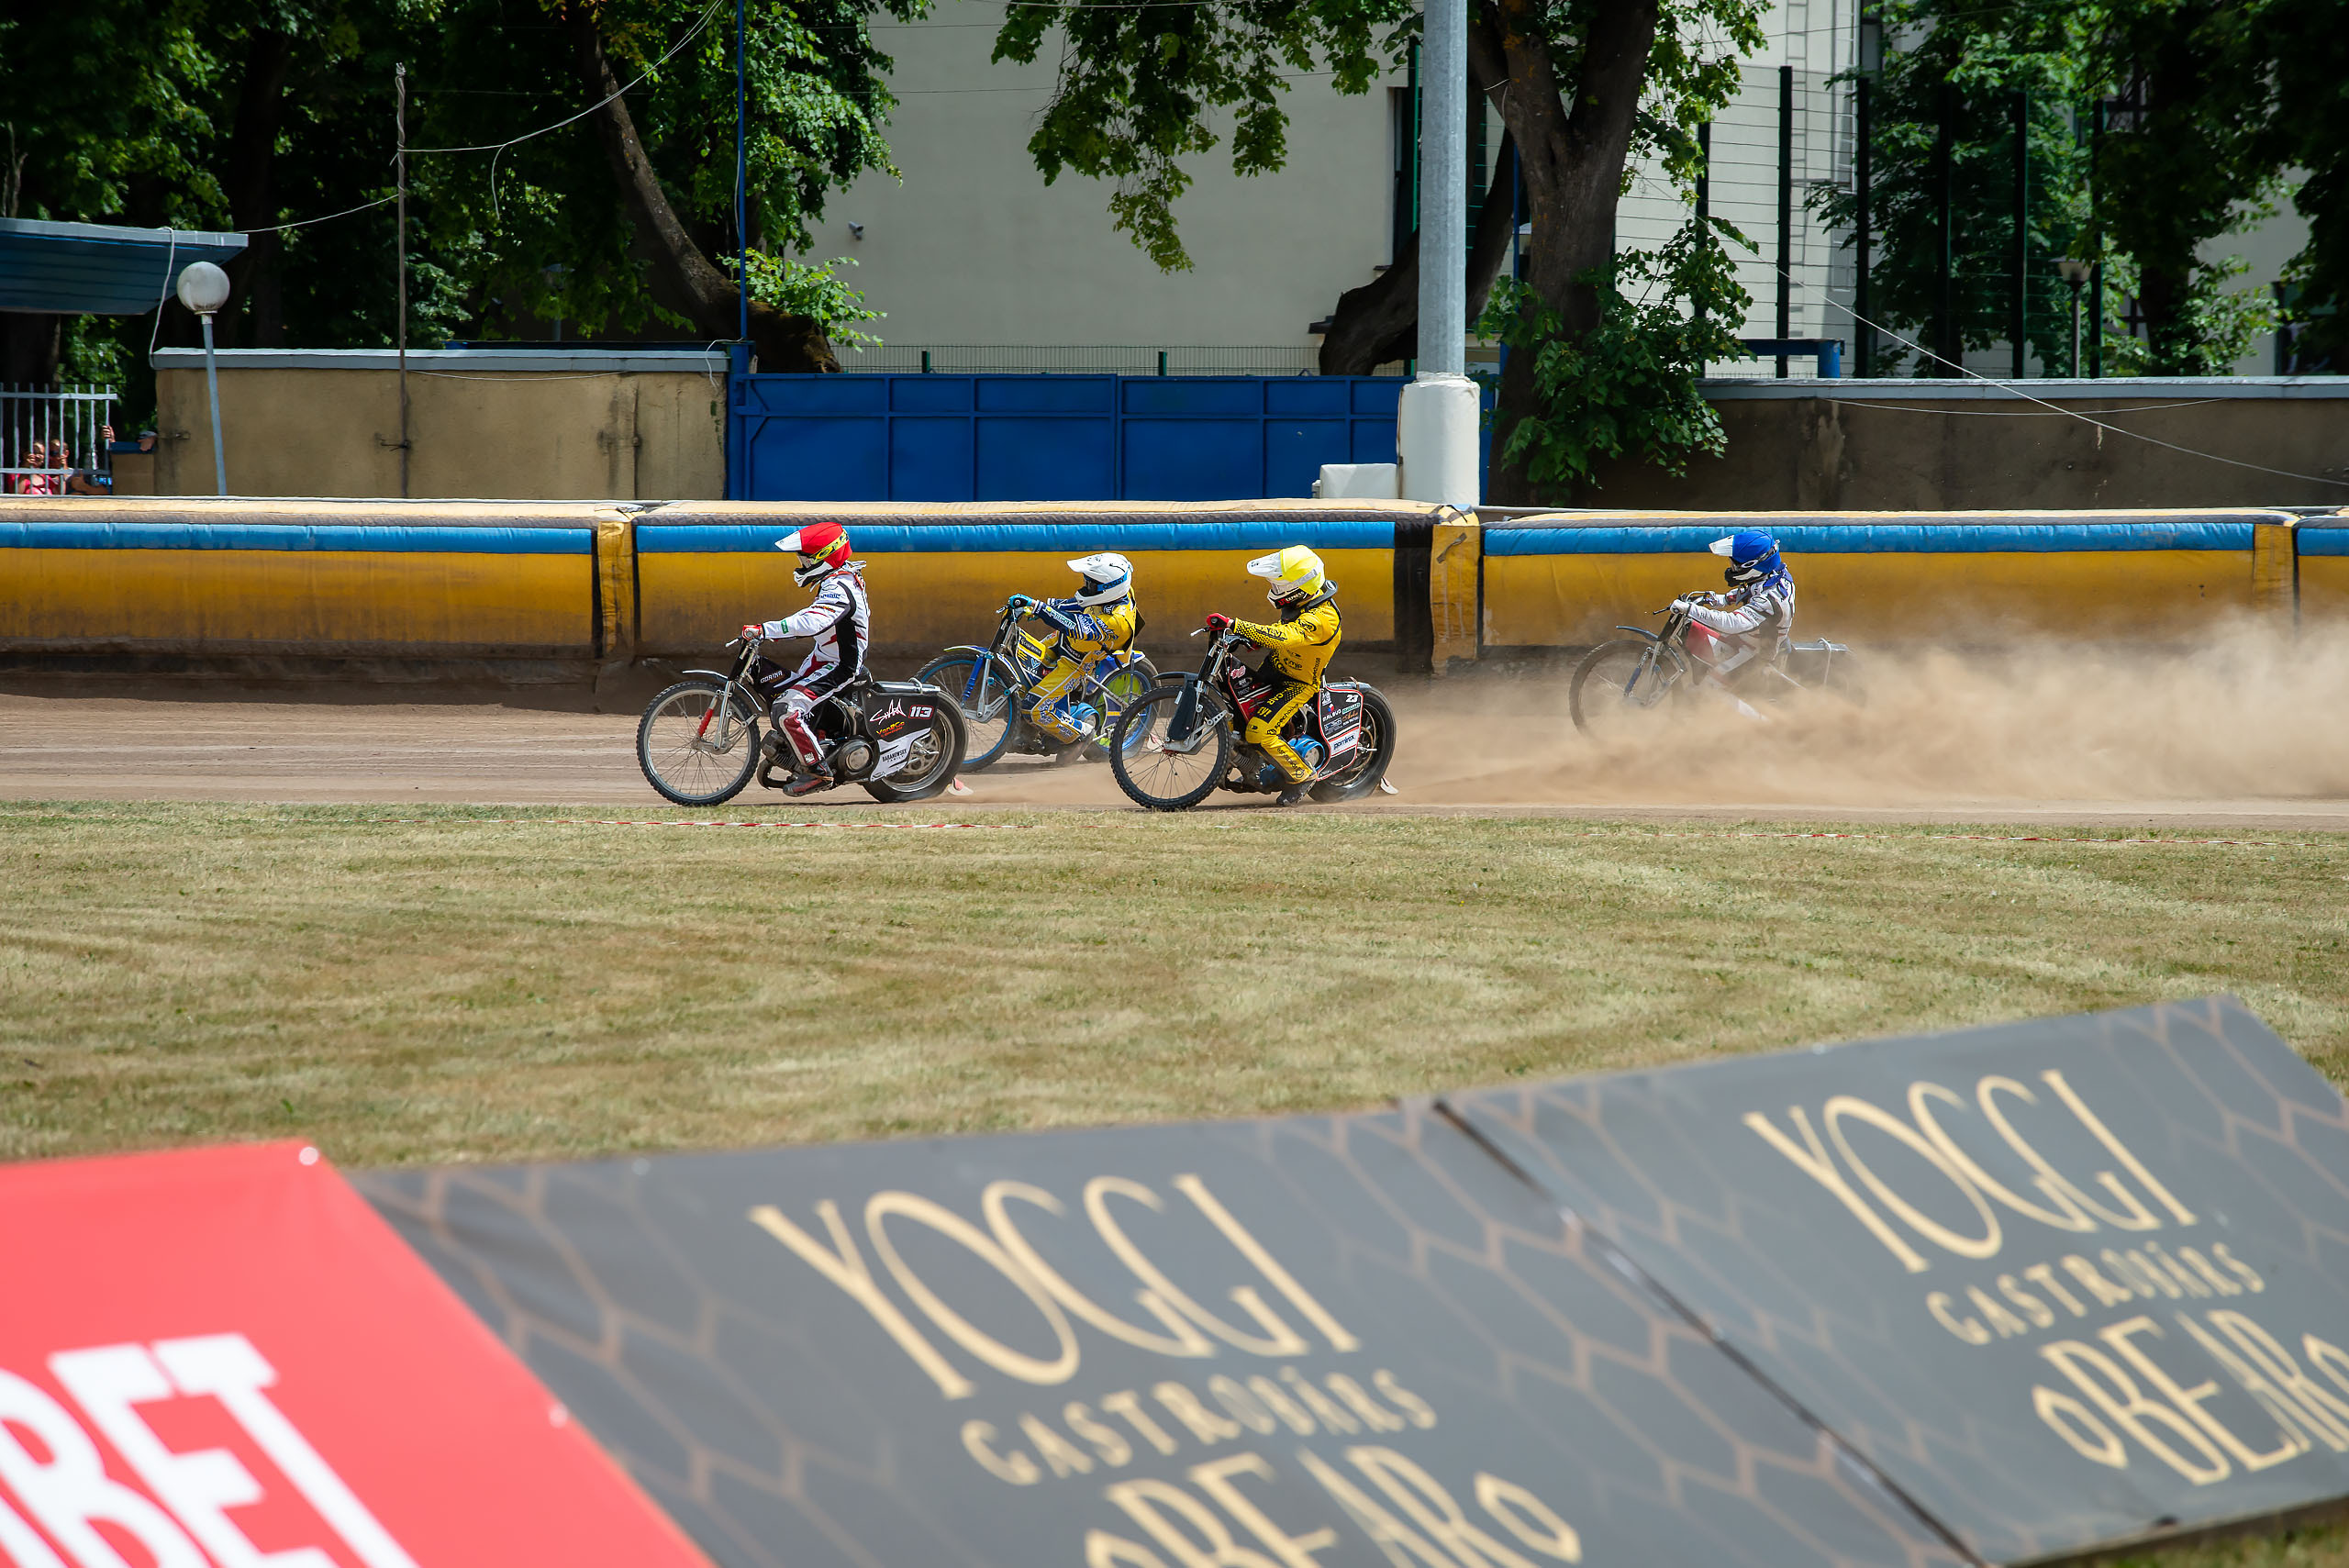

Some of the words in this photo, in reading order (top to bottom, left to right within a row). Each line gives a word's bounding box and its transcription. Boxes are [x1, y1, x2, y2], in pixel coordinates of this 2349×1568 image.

[909, 706, 933, 717] 113
[1345, 695, 1359, 703] 23
[1743, 1069, 2199, 1273] YOGGI
[748, 1173, 1362, 1400] YOGGI
